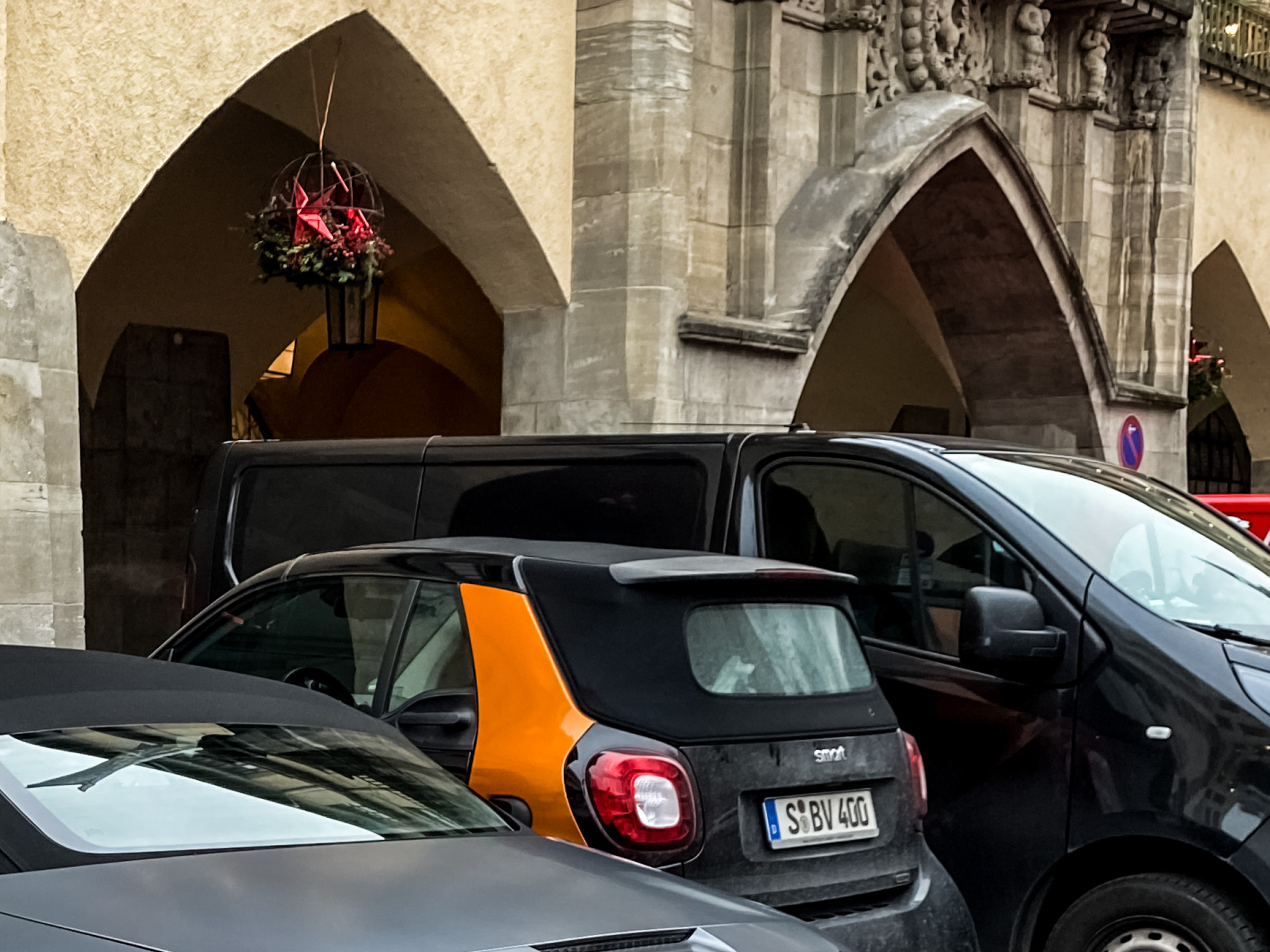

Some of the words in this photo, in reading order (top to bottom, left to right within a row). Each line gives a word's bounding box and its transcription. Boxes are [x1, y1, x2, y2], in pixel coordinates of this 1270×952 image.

[785, 802, 800, 835] S
[809, 798, 833, 833] BV
[838, 796, 869, 829] 400
